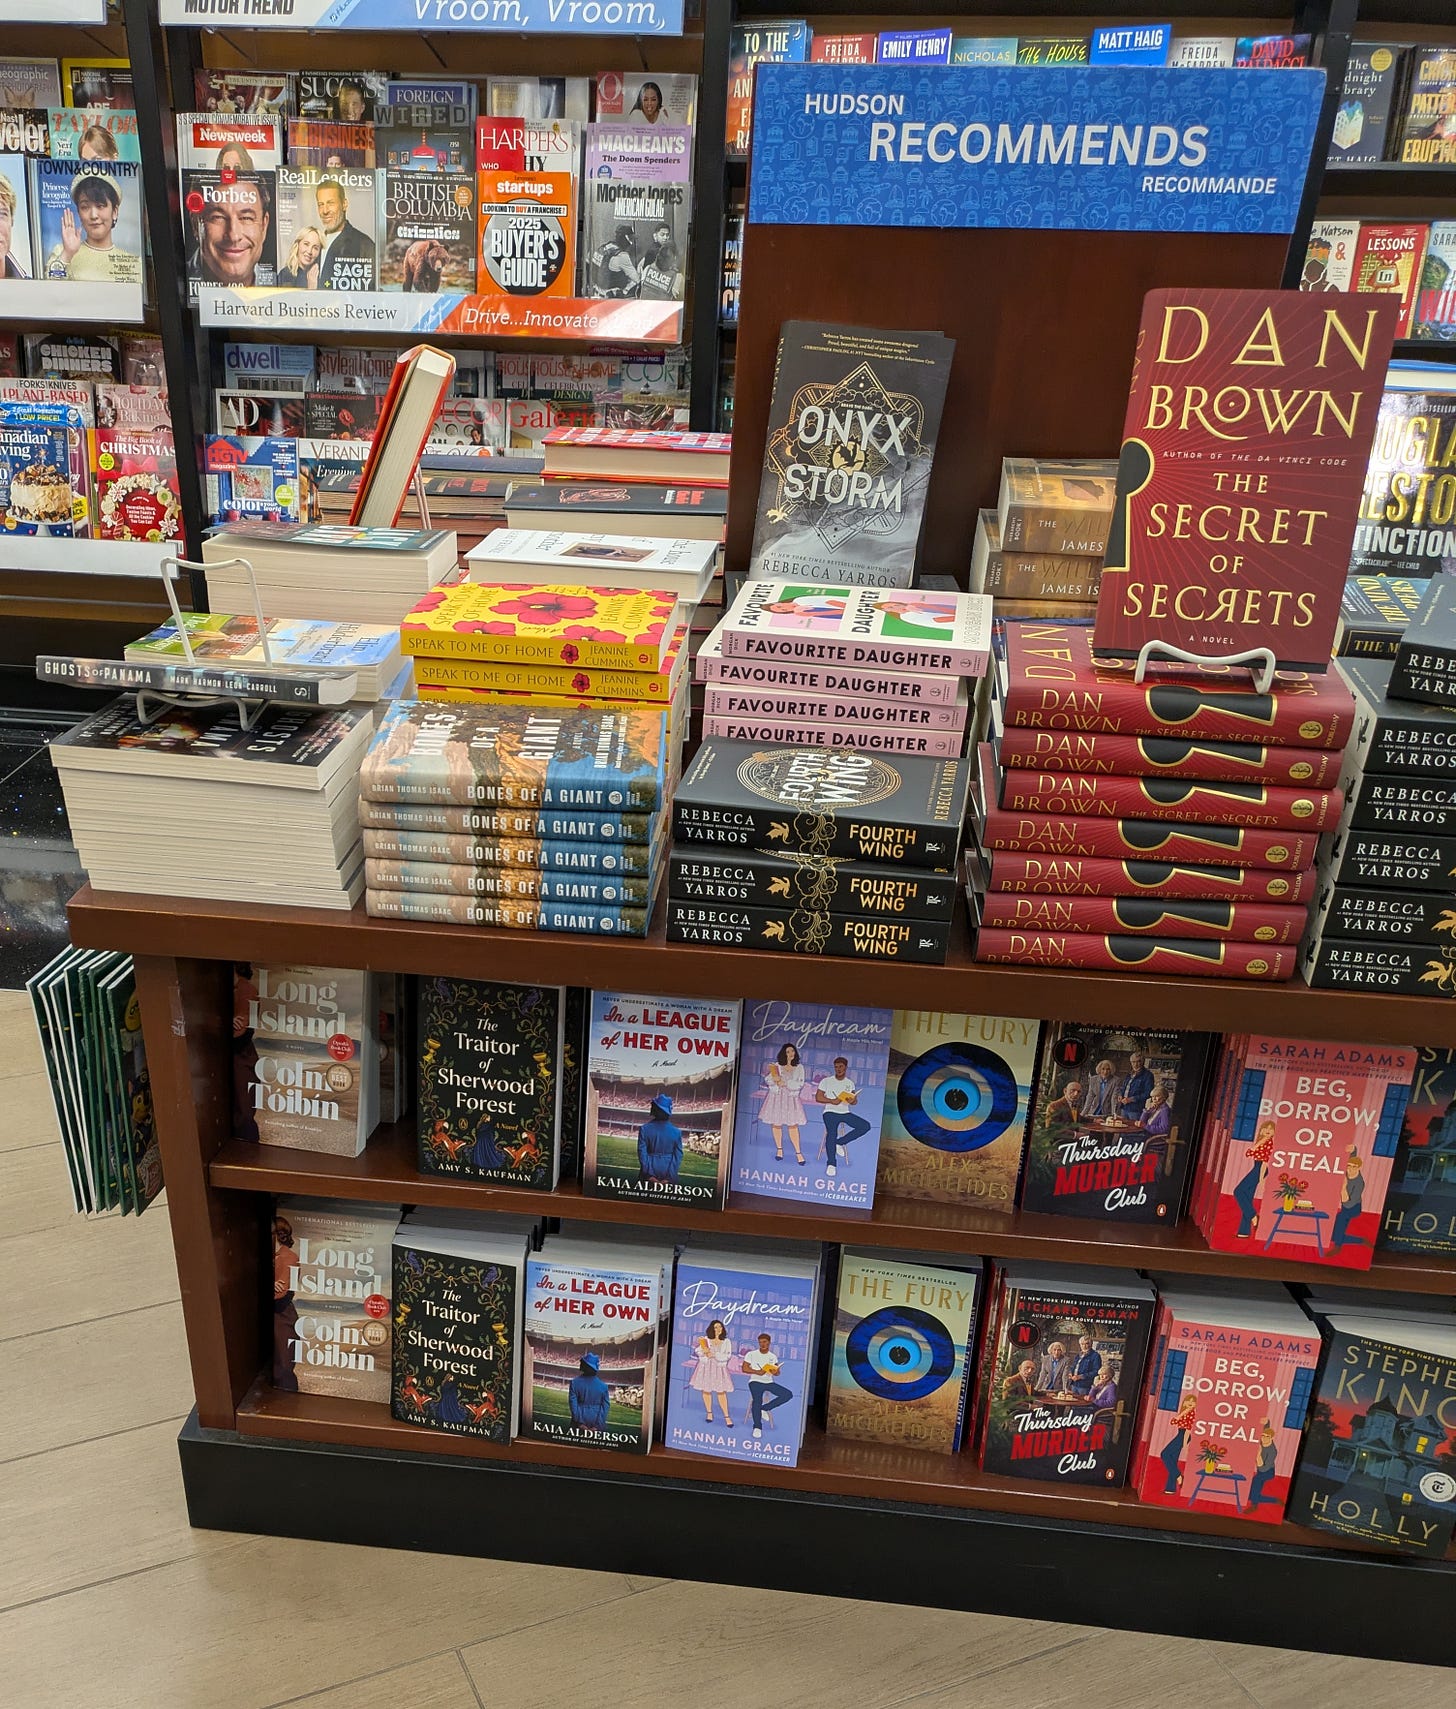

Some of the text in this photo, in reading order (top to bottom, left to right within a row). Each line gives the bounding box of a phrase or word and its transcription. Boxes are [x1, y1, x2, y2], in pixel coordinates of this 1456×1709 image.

[414, 0, 665, 30] Vroom, Vroom,
[745, 32, 789, 53] TO THE
[882, 38, 946, 59] EMILY HENRY
[1099, 29, 1163, 49] MATT HAIG
[1252, 40, 1294, 58] DAVID
[826, 43, 860, 56] FREIDA
[954, 51, 1010, 63] NICHOLAS
[1019, 45, 1087, 64] THE HOUSE
[1181, 47, 1218, 59] FREIDA
[396, 90, 454, 104] FOREIGN
[804, 94, 904, 115] HUDSON
[52, 112, 138, 134] TAYLOR
[375, 105, 466, 126] WIRED
[200, 128, 266, 144] Newsweek
[480, 128, 570, 151] HARPER'S
[598, 136, 685, 154] MACLEAN'S
[869, 123, 1209, 167] RECOMMENDS
[39, 161, 138, 177] TOWN&COUNTRY
[481, 162, 499, 170] WHO
[602, 155, 681, 164] The Doom Spenders
[279, 168, 372, 187] RealLeaders
[1142, 176, 1276, 194] RECOMMANDE
[202, 186, 256, 205] Forbes
[393, 183, 458, 200] BRITISH
[497, 182, 553, 194] startups
[597, 183, 683, 205] Mother Jones
[383, 199, 472, 220] COLUMBIA
[484, 205, 507, 213] LOOKING
[508, 205, 515, 214] TO
[516, 205, 526, 214] BUY
[531, 206, 565, 215] FRANCHISE?
[397, 226, 460, 240] Grizzlies
[509, 218, 541, 229] 2025
[1320, 226, 1353, 236] Watson
[491, 227, 558, 258] BUYER'S
[1367, 238, 1415, 250] LESSONS
[333, 265, 371, 277] SAGE
[500, 259, 547, 287] GUIDE
[647, 269, 670, 284] POLICE
[1379, 270, 1391, 281] In
[331, 278, 371, 291] TONY
[214, 301, 397, 319] Harvard Business Review
[1155, 306, 1379, 371] DAN
[41, 345, 112, 359] CHICKEN
[227, 350, 279, 368] dwell
[42, 359, 112, 373] DINNERS
[19, 380, 76, 390] FORKS KNIVES
[10, 391, 89, 403] PLANT-BASED
[226, 398, 259, 427] AD
[510, 404, 601, 428] Galerie
[1144, 385, 1363, 441] BROWN
[798, 405, 912, 456] ONYX
[101, 442, 175, 457] CHRISTMAS
[209, 450, 247, 462] HGTV
[1163, 451, 1202, 459] AUTHOR
[1231, 454, 1250, 462] THE
[1279, 457, 1311, 465] VINCI
[784, 463, 902, 513] STORM
[1212, 473, 1268, 493] THE
[224, 500, 262, 511] color
[1146, 503, 1327, 546] SECRET
[763, 559, 897, 588] REBECCA YARROS
[1209, 554, 1244, 574] OF
[408, 638, 554, 658] SPEAK TO ME OF HOME
[1202, 636, 1234, 645] NOVEL
[585, 655, 634, 668] CUMMINS
[590, 646, 629, 657] JEANINE
[746, 639, 952, 669] FAVOURITE DAUGHTER
[45, 662, 90, 678] GHOSTS
[104, 666, 151, 683] PANAMA
[170, 675, 190, 685] MARK
[193, 677, 221, 687] HARMON
[224, 680, 242, 689] LEON
[246, 682, 277, 693] CARROLL
[1040, 688, 1103, 713] DAN
[1014, 711, 1121, 733] BROWN
[372, 784, 603, 804] BRIAN THOMAS ISAAC BONES OF A GIANT
[680, 808, 755, 826] REBECCA
[685, 827, 748, 844] YARROS
[849, 824, 916, 845] FOURTH
[858, 841, 904, 859] WING
[1328, 951, 1412, 966] REBECCA
[1330, 968, 1400, 984] YARROS
[258, 968, 337, 1014] Long
[248, 1000, 345, 1039] Island
[477, 1018, 498, 1032] The
[454, 1032, 520, 1055] Traitor
[255, 1056, 331, 1092] Colm
[479, 1057, 492, 1073] of
[438, 1068, 535, 1095] Sherwood
[248, 1082, 339, 1120] Tóibín
[456, 1092, 516, 1115] Forest
[1059, 1137, 1144, 1165] Thursday
[1080, 1136, 1097, 1147] The
[438, 1163, 532, 1182] AMY S. KAUFMAN
[1053, 1154, 1159, 1197] MURDER
[1104, 1187, 1146, 1212] Club
[536, 1275, 554, 1290] In
[571, 1278, 650, 1300] LEAGUE
[848, 1274, 970, 1312] THE FURY
[534, 1297, 650, 1321] of HER OWN
[682, 1280, 805, 1325] Daydream
[1018, 1302, 1138, 1320] RICHARD OSMAN
[1181, 1327, 1312, 1354] SARAH ADAMS
[1215, 1358, 1265, 1382] BEG,
[1182, 1374, 1290, 1407] BORROW,
[1215, 1402, 1248, 1419] OR
[533, 1421, 638, 1444] KAIA ALDERSON
[673, 1428, 791, 1455] HANNAH GRACE
[1195, 1421, 1259, 1444] STEAL
[752, 1453, 790, 1462] ICEBREAKER
[1310, 1491, 1439, 1540] HOLLY
